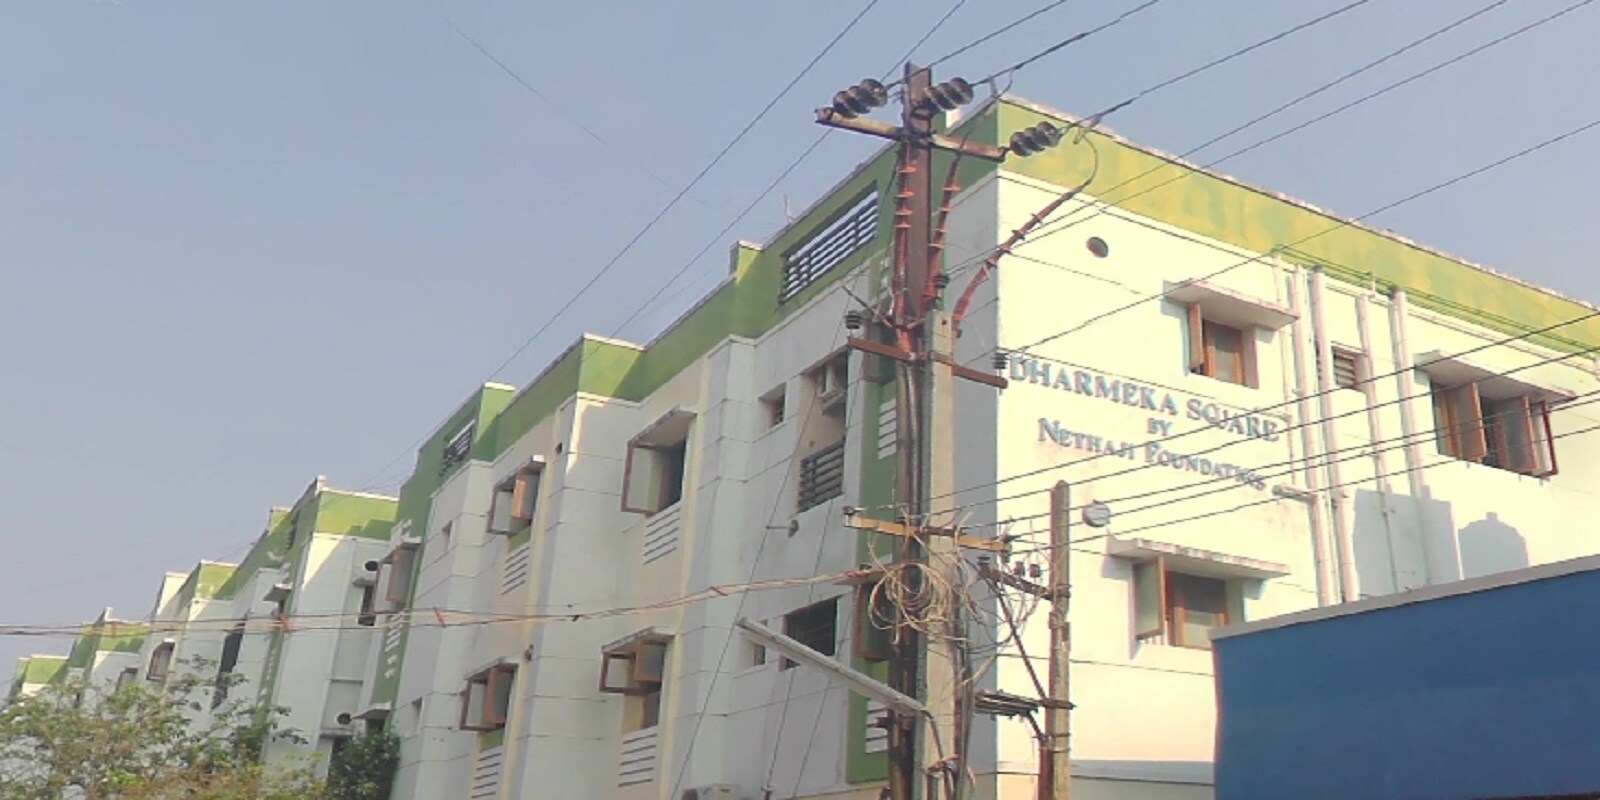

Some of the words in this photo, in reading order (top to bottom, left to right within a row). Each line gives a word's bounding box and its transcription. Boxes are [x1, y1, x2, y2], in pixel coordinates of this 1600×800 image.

[1009, 355, 1177, 416] DHARMEKA
[1186, 398, 1279, 442] SQUARE
[1147, 417, 1172, 436] BY
